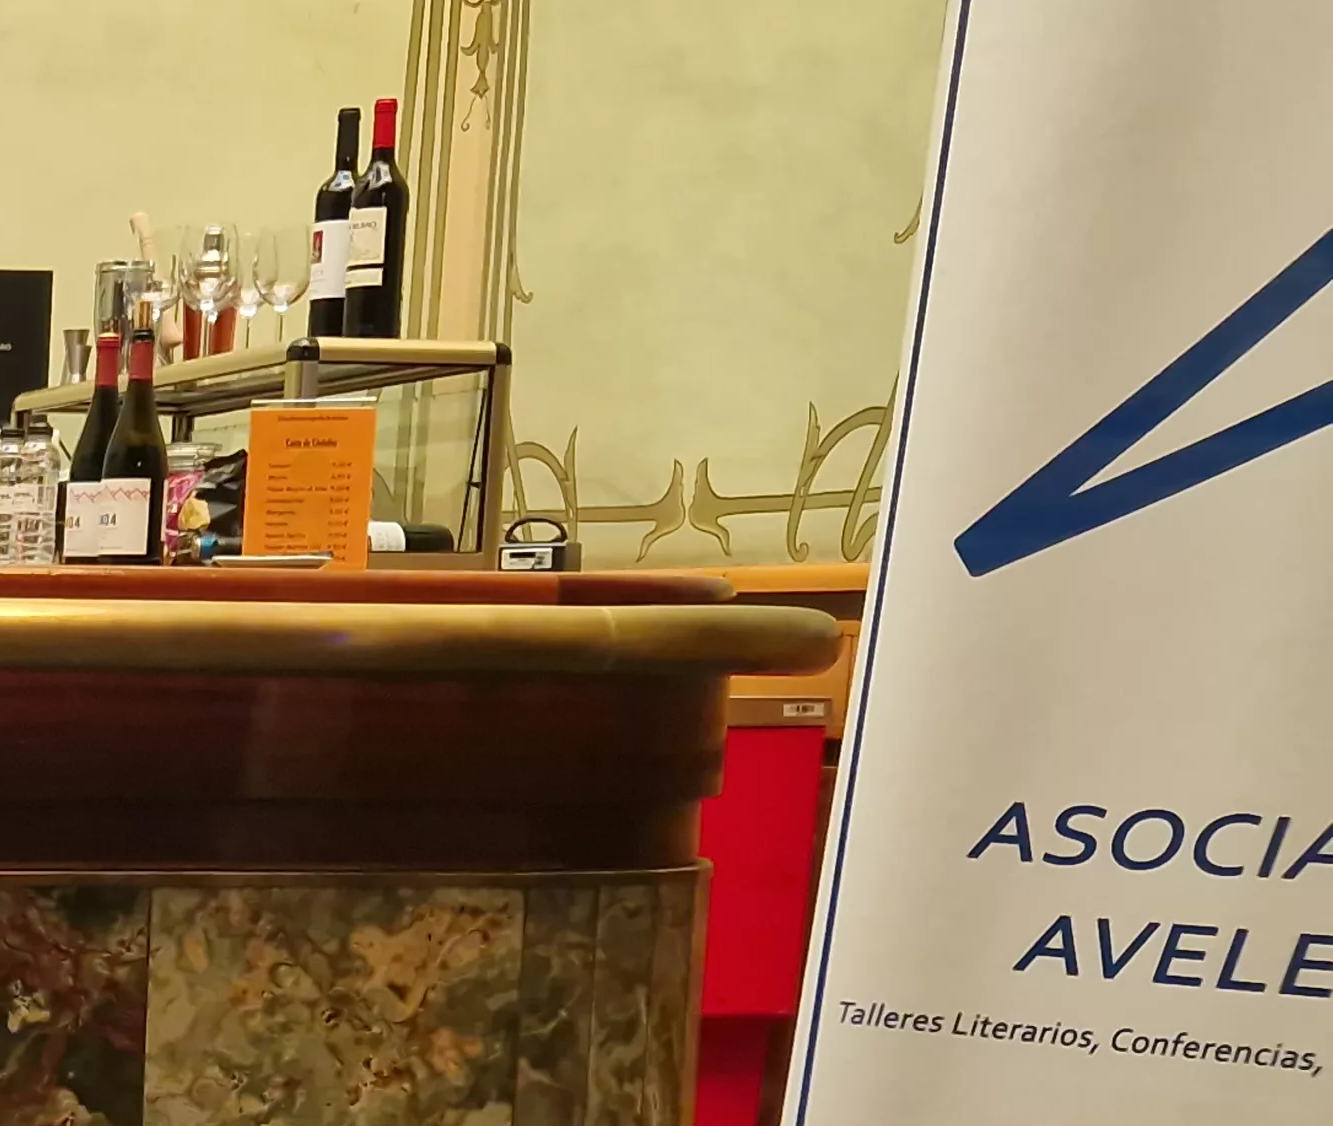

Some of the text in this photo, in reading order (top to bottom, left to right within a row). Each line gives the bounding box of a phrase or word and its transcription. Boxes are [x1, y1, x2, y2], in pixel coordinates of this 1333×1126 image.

[967, 802, 1333, 880] ASOCIA
[1013, 915, 1333, 999] AVELE
[839, 1001, 1323, 1078] Talleres Literarios, Conferencias,
